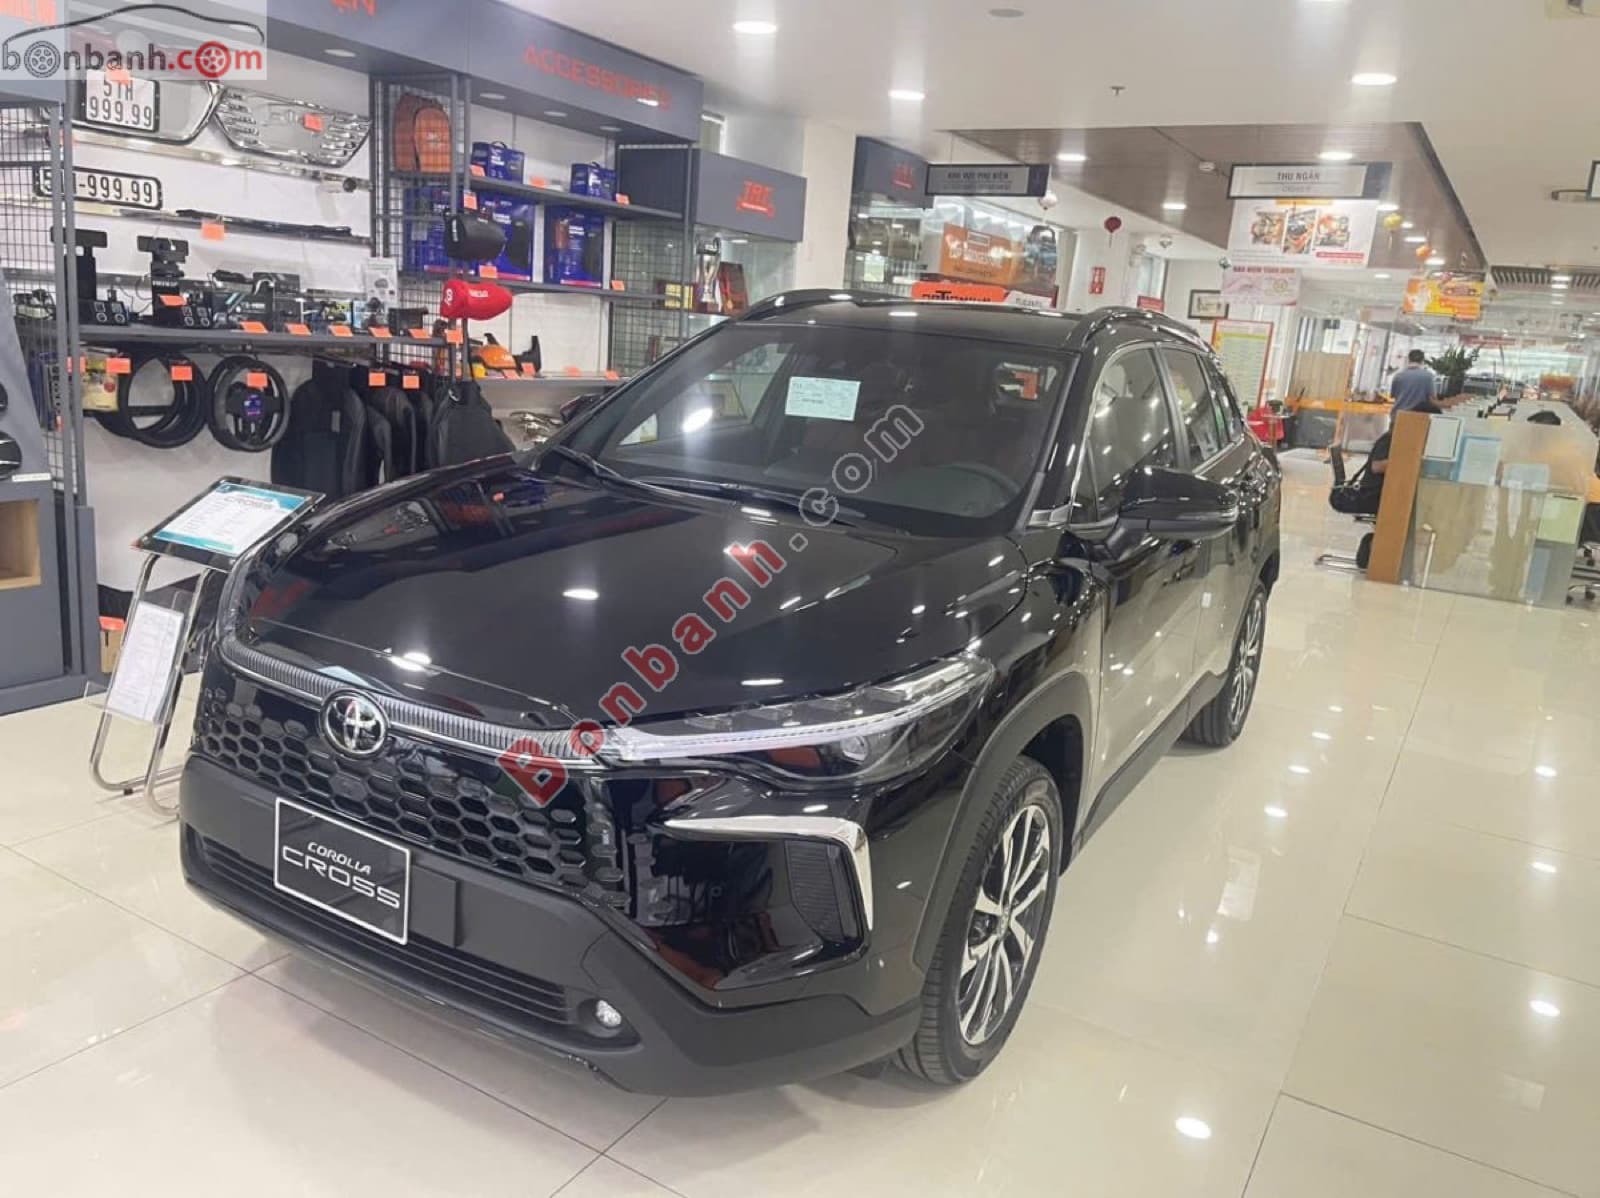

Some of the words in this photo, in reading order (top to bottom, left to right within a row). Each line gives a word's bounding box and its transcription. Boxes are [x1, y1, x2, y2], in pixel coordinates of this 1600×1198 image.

[89, 95, 153, 128] 999.99
[307, 841, 372, 875] COROLLA
[282, 845, 400, 909] CROSS
